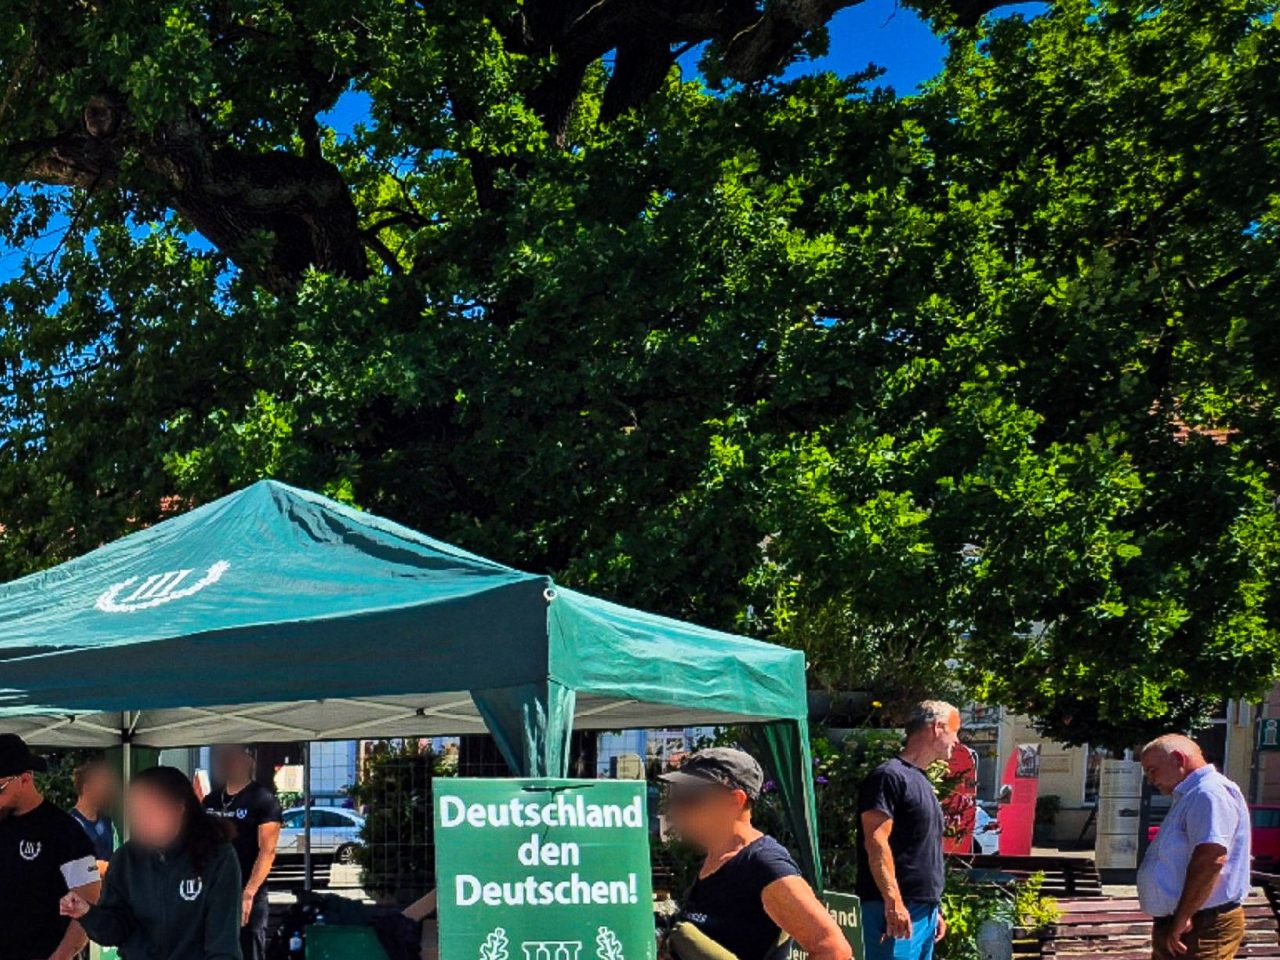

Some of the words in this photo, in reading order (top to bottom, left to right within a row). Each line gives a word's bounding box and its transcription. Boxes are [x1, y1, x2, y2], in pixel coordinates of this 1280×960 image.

[439, 794, 643, 829] Deutschland
[518, 833, 580, 867] den
[455, 873, 638, 906] Deutschen!
